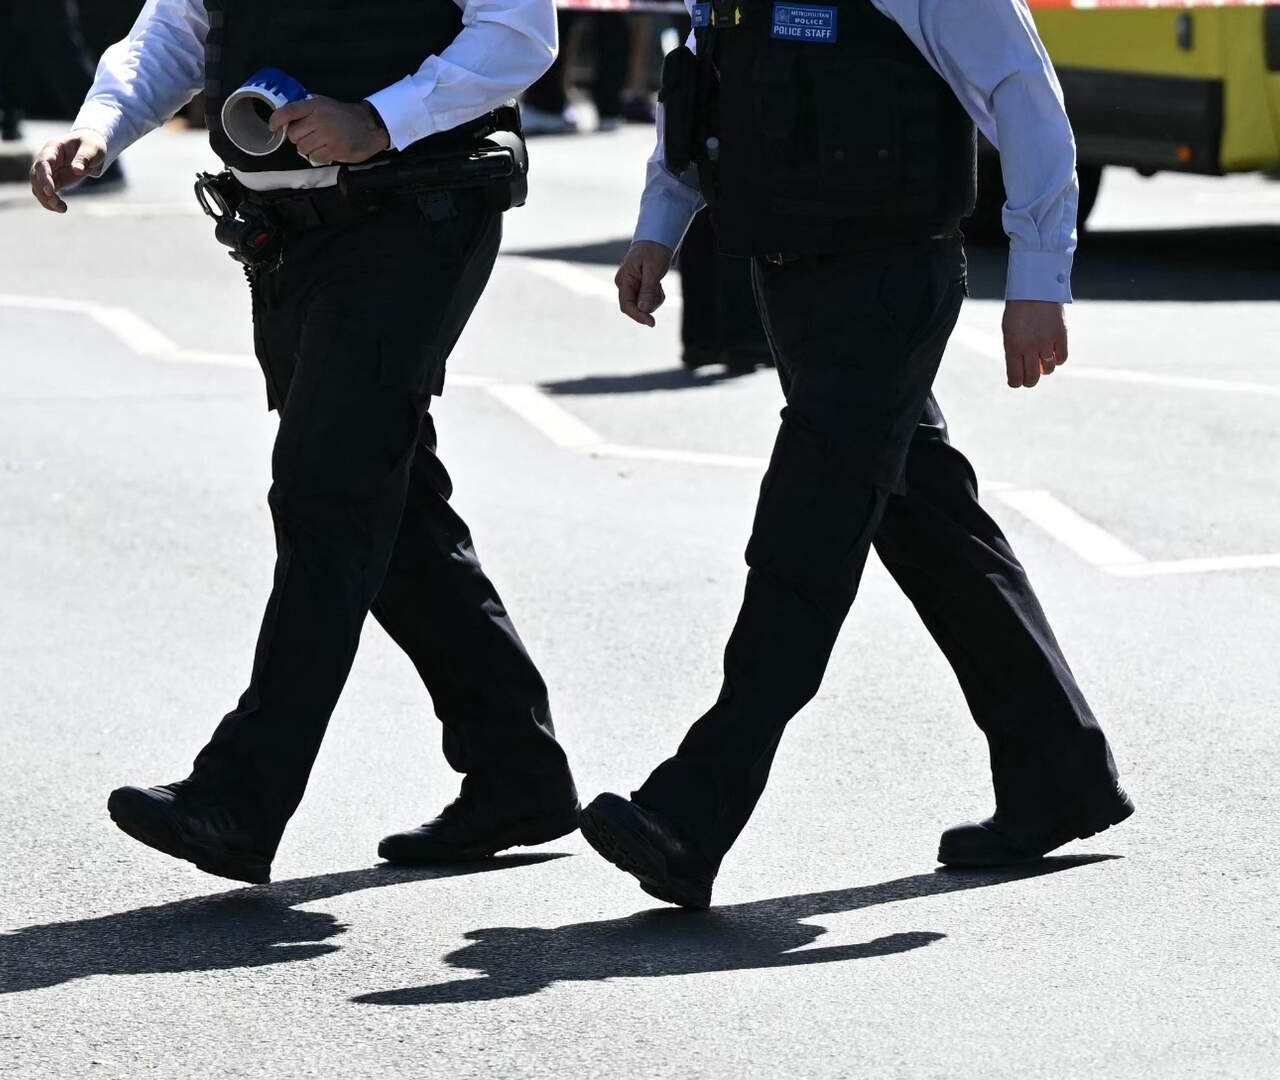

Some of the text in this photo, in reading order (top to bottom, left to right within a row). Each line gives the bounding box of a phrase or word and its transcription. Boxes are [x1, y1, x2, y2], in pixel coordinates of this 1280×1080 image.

[790, 9, 830, 19] METROPOLITAN
[773, 25, 832, 39] POLICE STAFF
